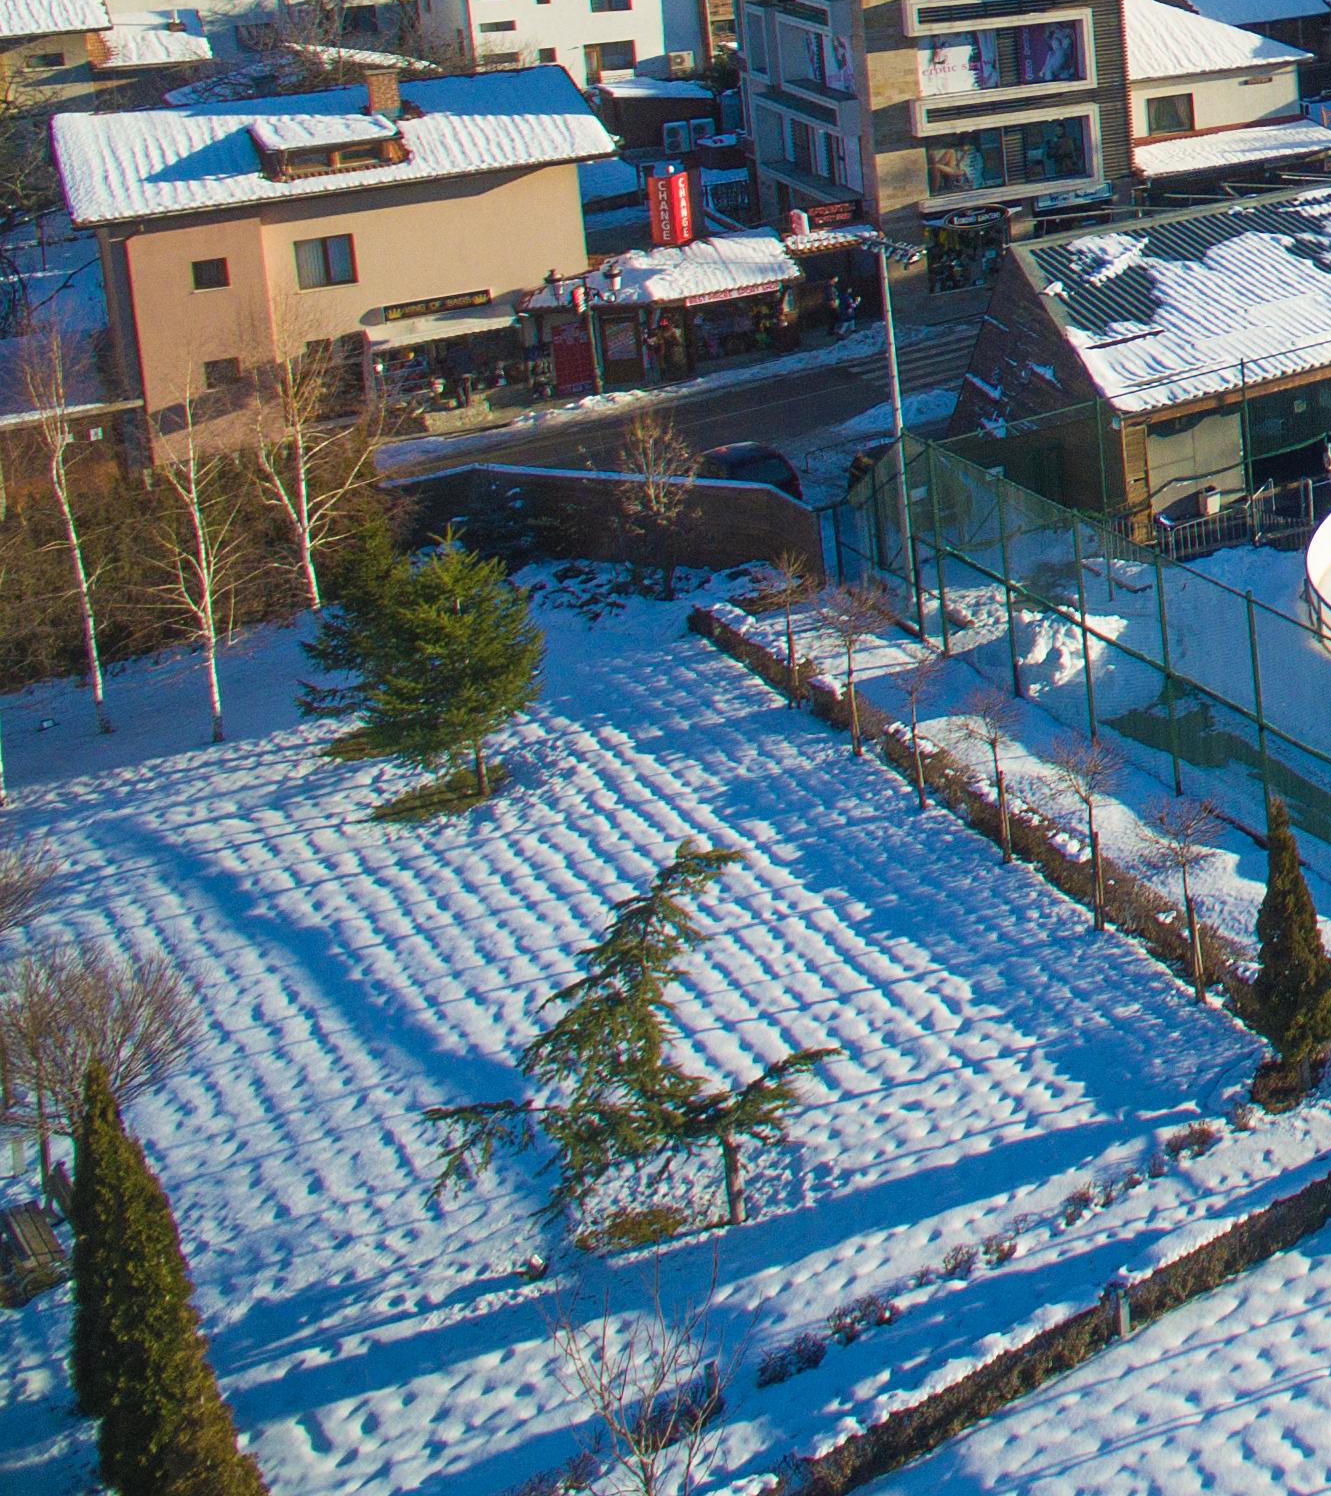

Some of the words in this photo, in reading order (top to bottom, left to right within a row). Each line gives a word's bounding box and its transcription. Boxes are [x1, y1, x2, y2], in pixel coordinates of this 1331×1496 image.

[922, 61, 957, 78] erotic
[657, 180, 672, 241] CHANGE
[677, 177, 690, 239] CHANGE
